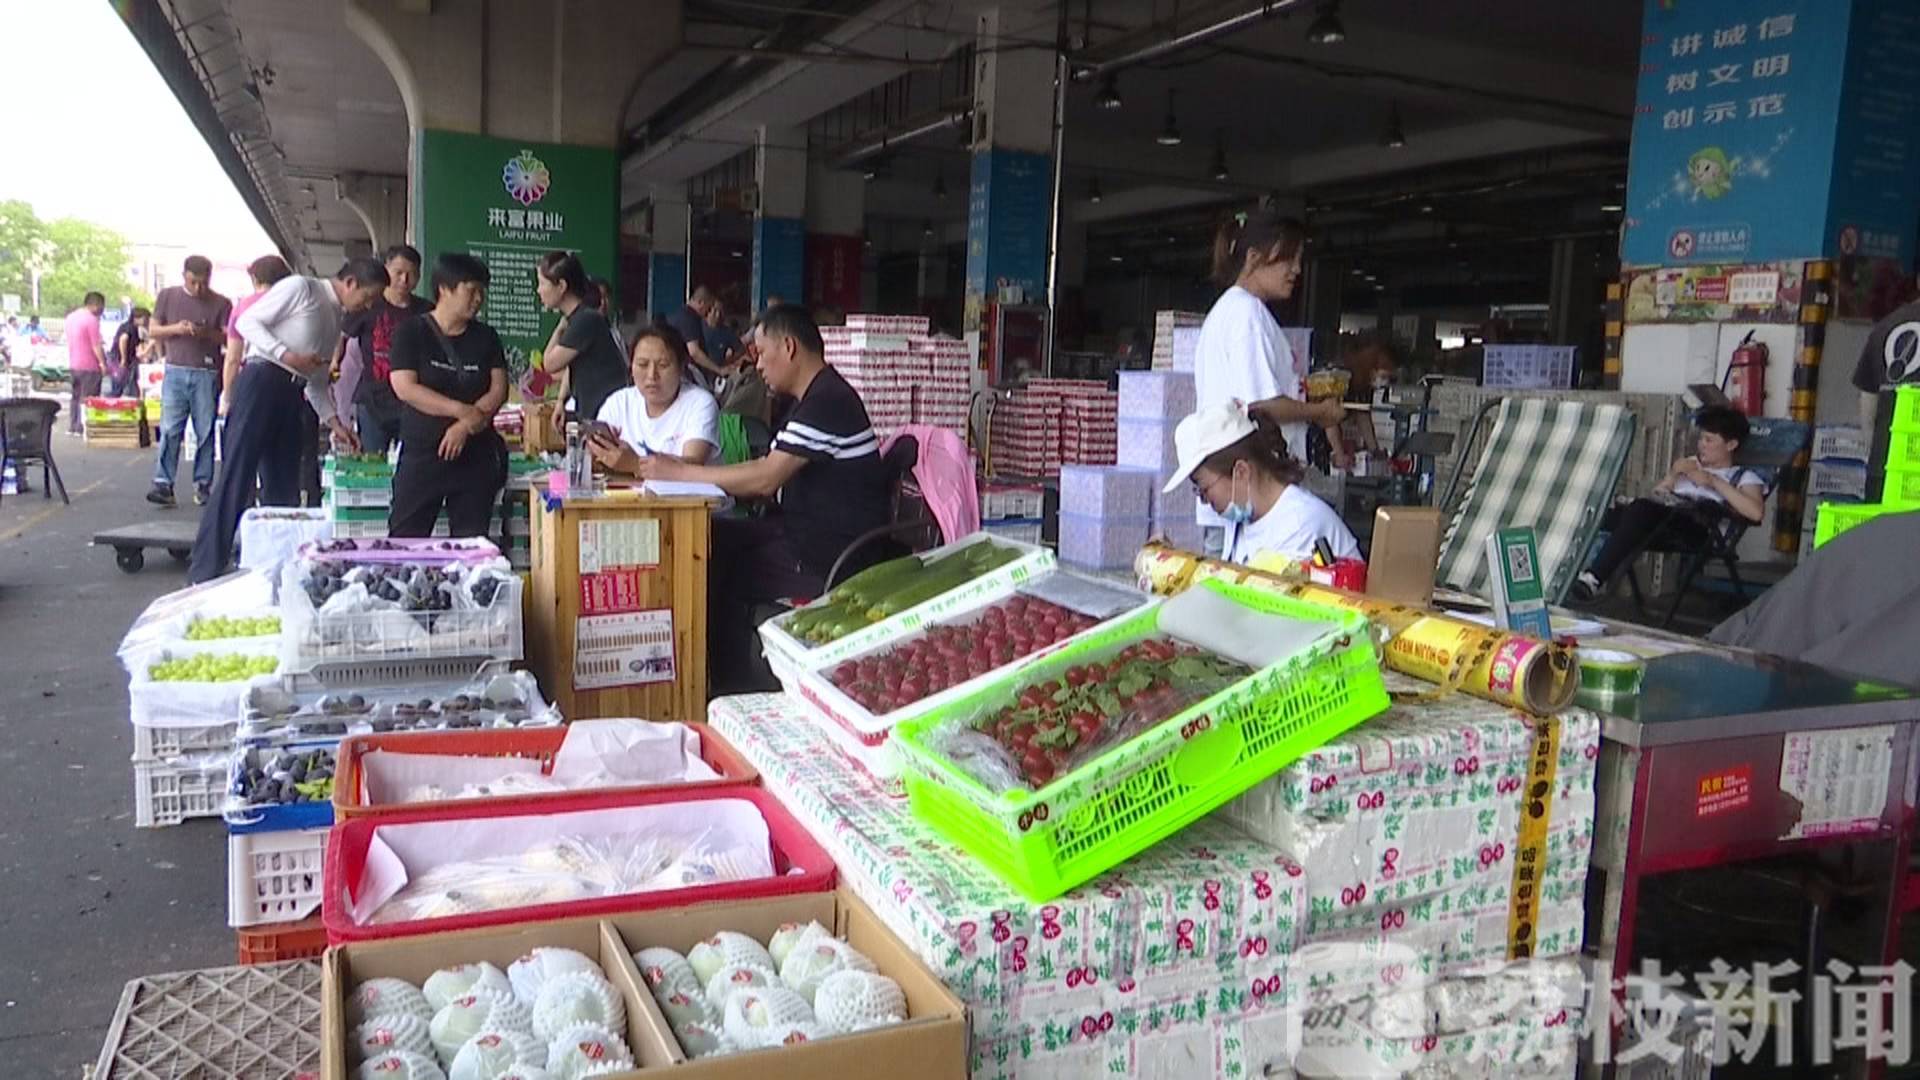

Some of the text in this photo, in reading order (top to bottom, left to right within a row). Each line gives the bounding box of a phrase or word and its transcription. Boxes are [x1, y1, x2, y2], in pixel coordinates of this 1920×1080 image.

[1670, 14, 1796, 56] 讲诚信
[1666, 54, 1791, 94] 树文明
[1662, 93, 1787, 130] 创示范
[488, 207, 564, 232] 来富果业
[499, 230, 551, 241] LAIFU FRUIT
